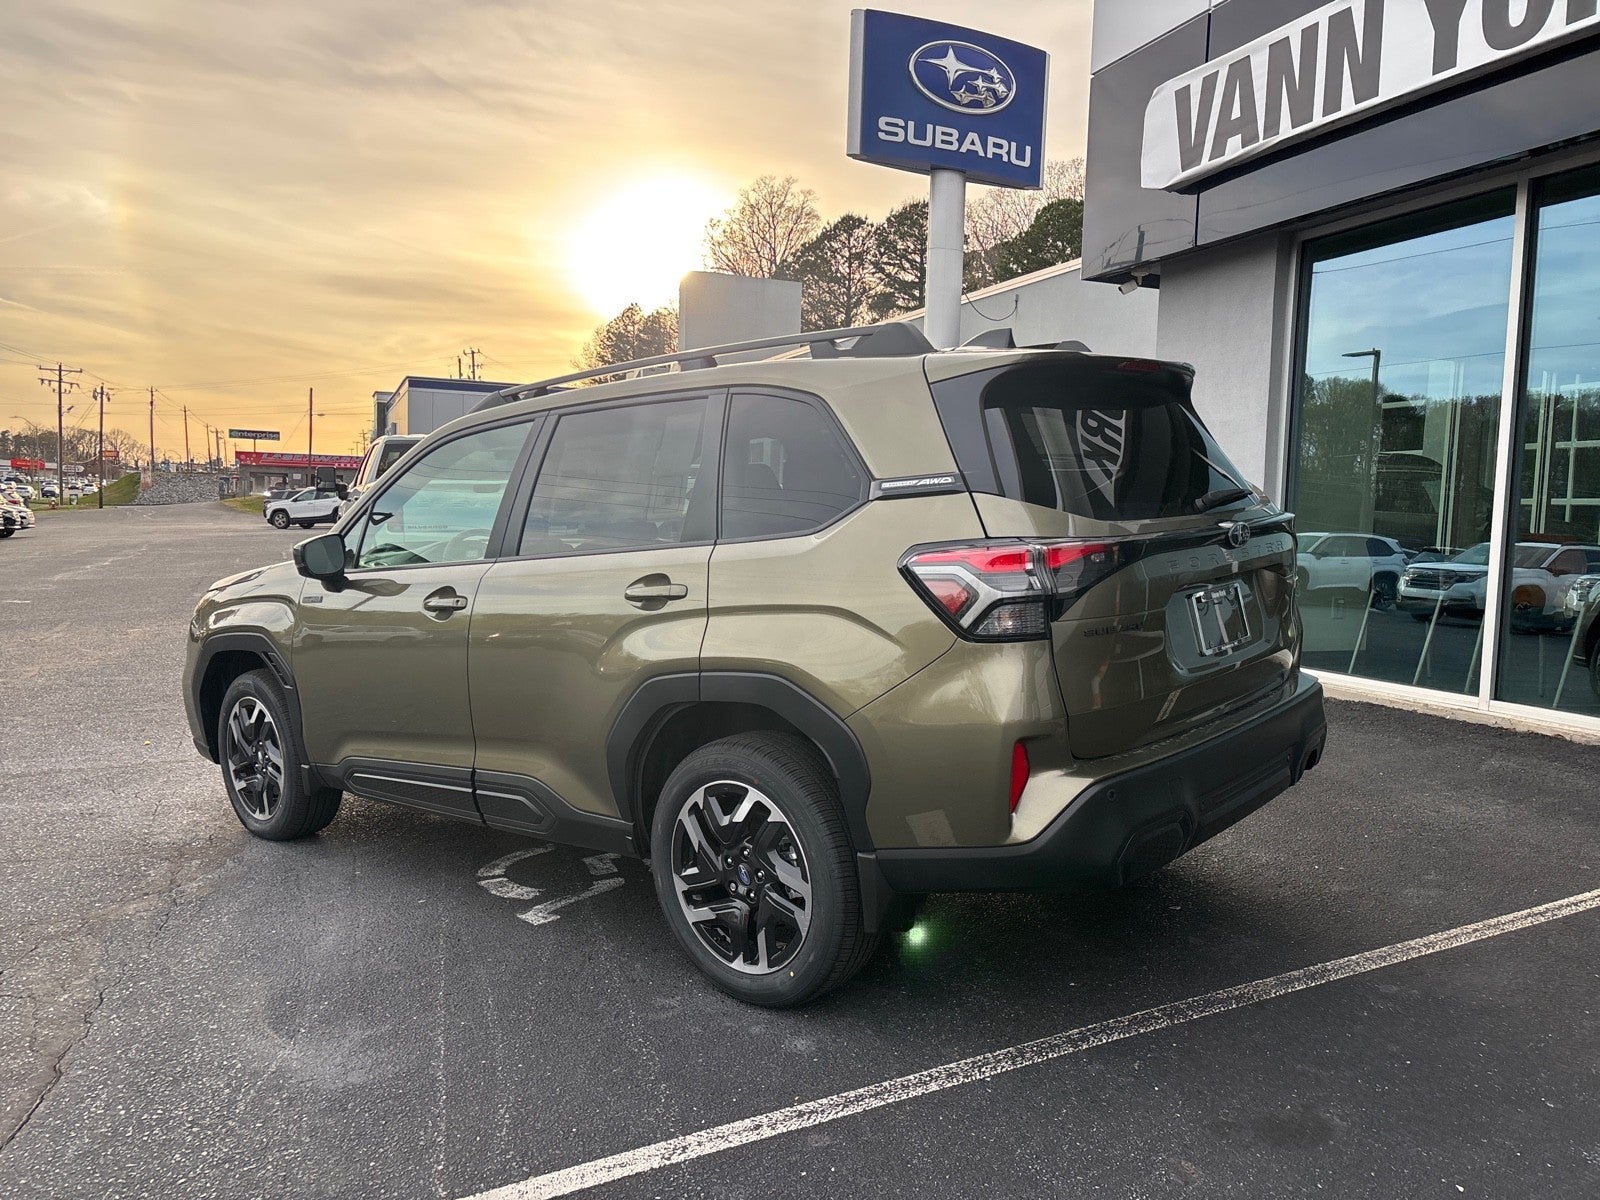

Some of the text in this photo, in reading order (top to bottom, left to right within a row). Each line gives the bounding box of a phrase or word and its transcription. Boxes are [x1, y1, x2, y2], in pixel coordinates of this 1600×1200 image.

[1174, 0, 1385, 173] VANN
[877, 116, 1032, 168] SUBARU
[231, 430, 280, 440] enterprise
[917, 476, 954, 486] AWD
